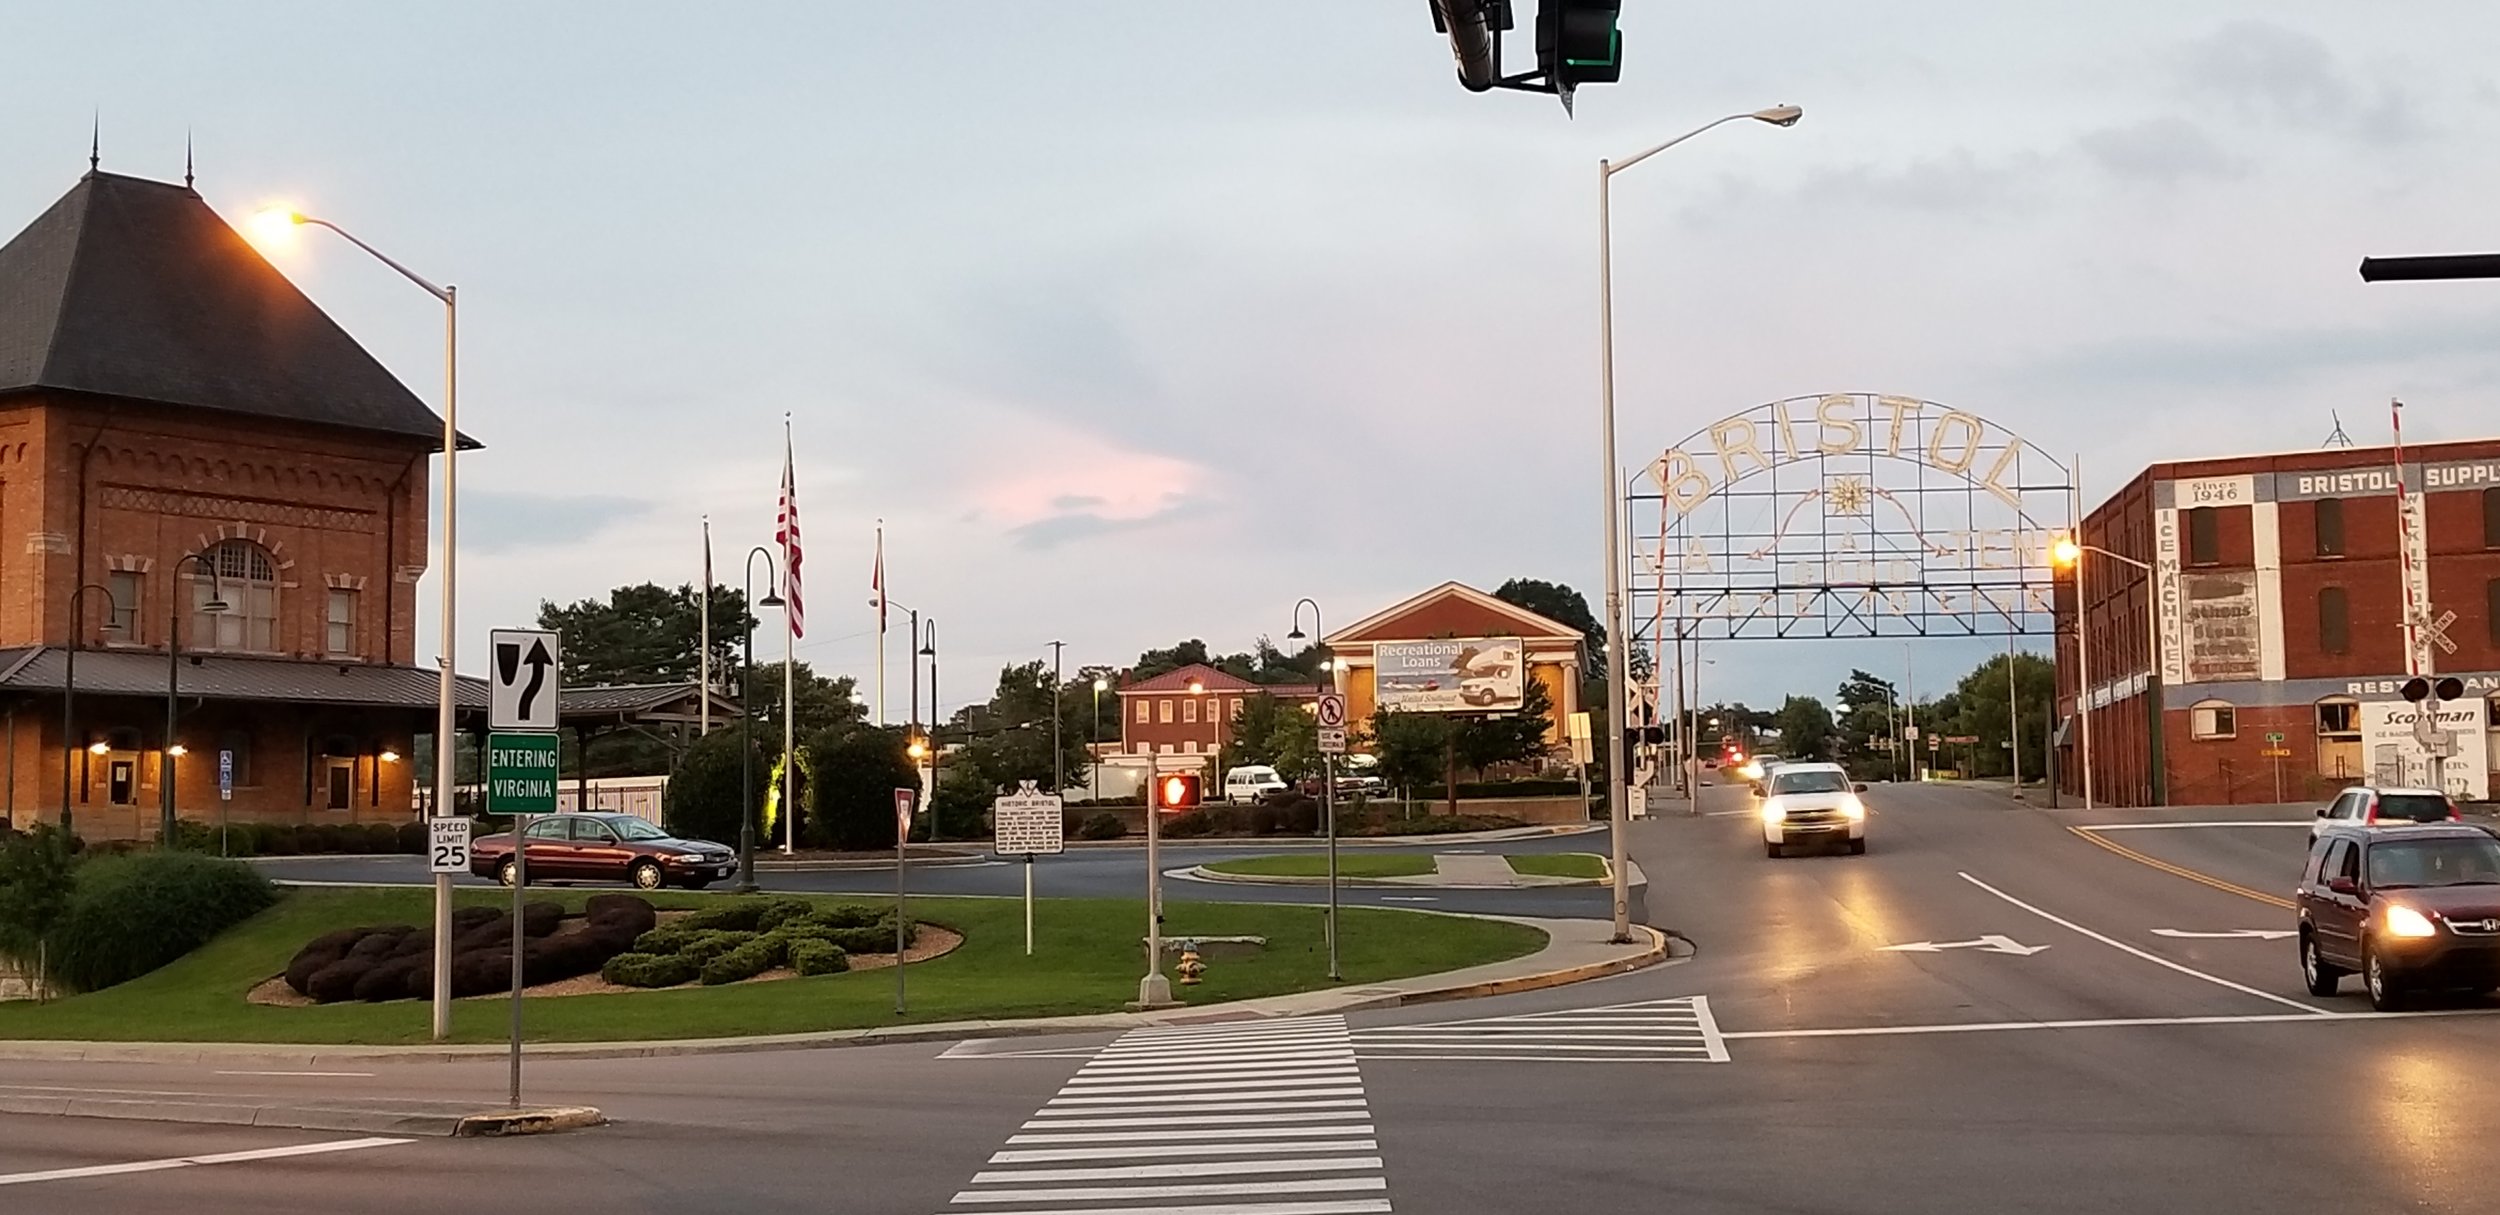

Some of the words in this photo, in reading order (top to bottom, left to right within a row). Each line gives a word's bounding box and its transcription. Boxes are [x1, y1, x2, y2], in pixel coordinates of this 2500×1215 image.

[1647, 394, 2023, 514] BRISTOL
[2192, 481, 2237, 490] Since
[2300, 471, 2398, 494] BRISTOL
[2427, 465, 2500, 486] SUPPL
[2193, 489, 2238, 502] 1946
[2160, 511, 2175, 552] ICE
[2159, 559, 2179, 677] MACHINES
[1379, 642, 1464, 657] Recreational
[1402, 656, 1441, 668] Loans
[2348, 677, 2499, 695] RESTAN
[2384, 711, 2475, 725] Scoman
[491, 749, 556, 768] ENTERING
[494, 779, 552, 797] VIRGINIA
[433, 822, 468, 832] SPEED
[436, 834, 464, 843] LIMIT
[434, 846, 466, 866] 25
